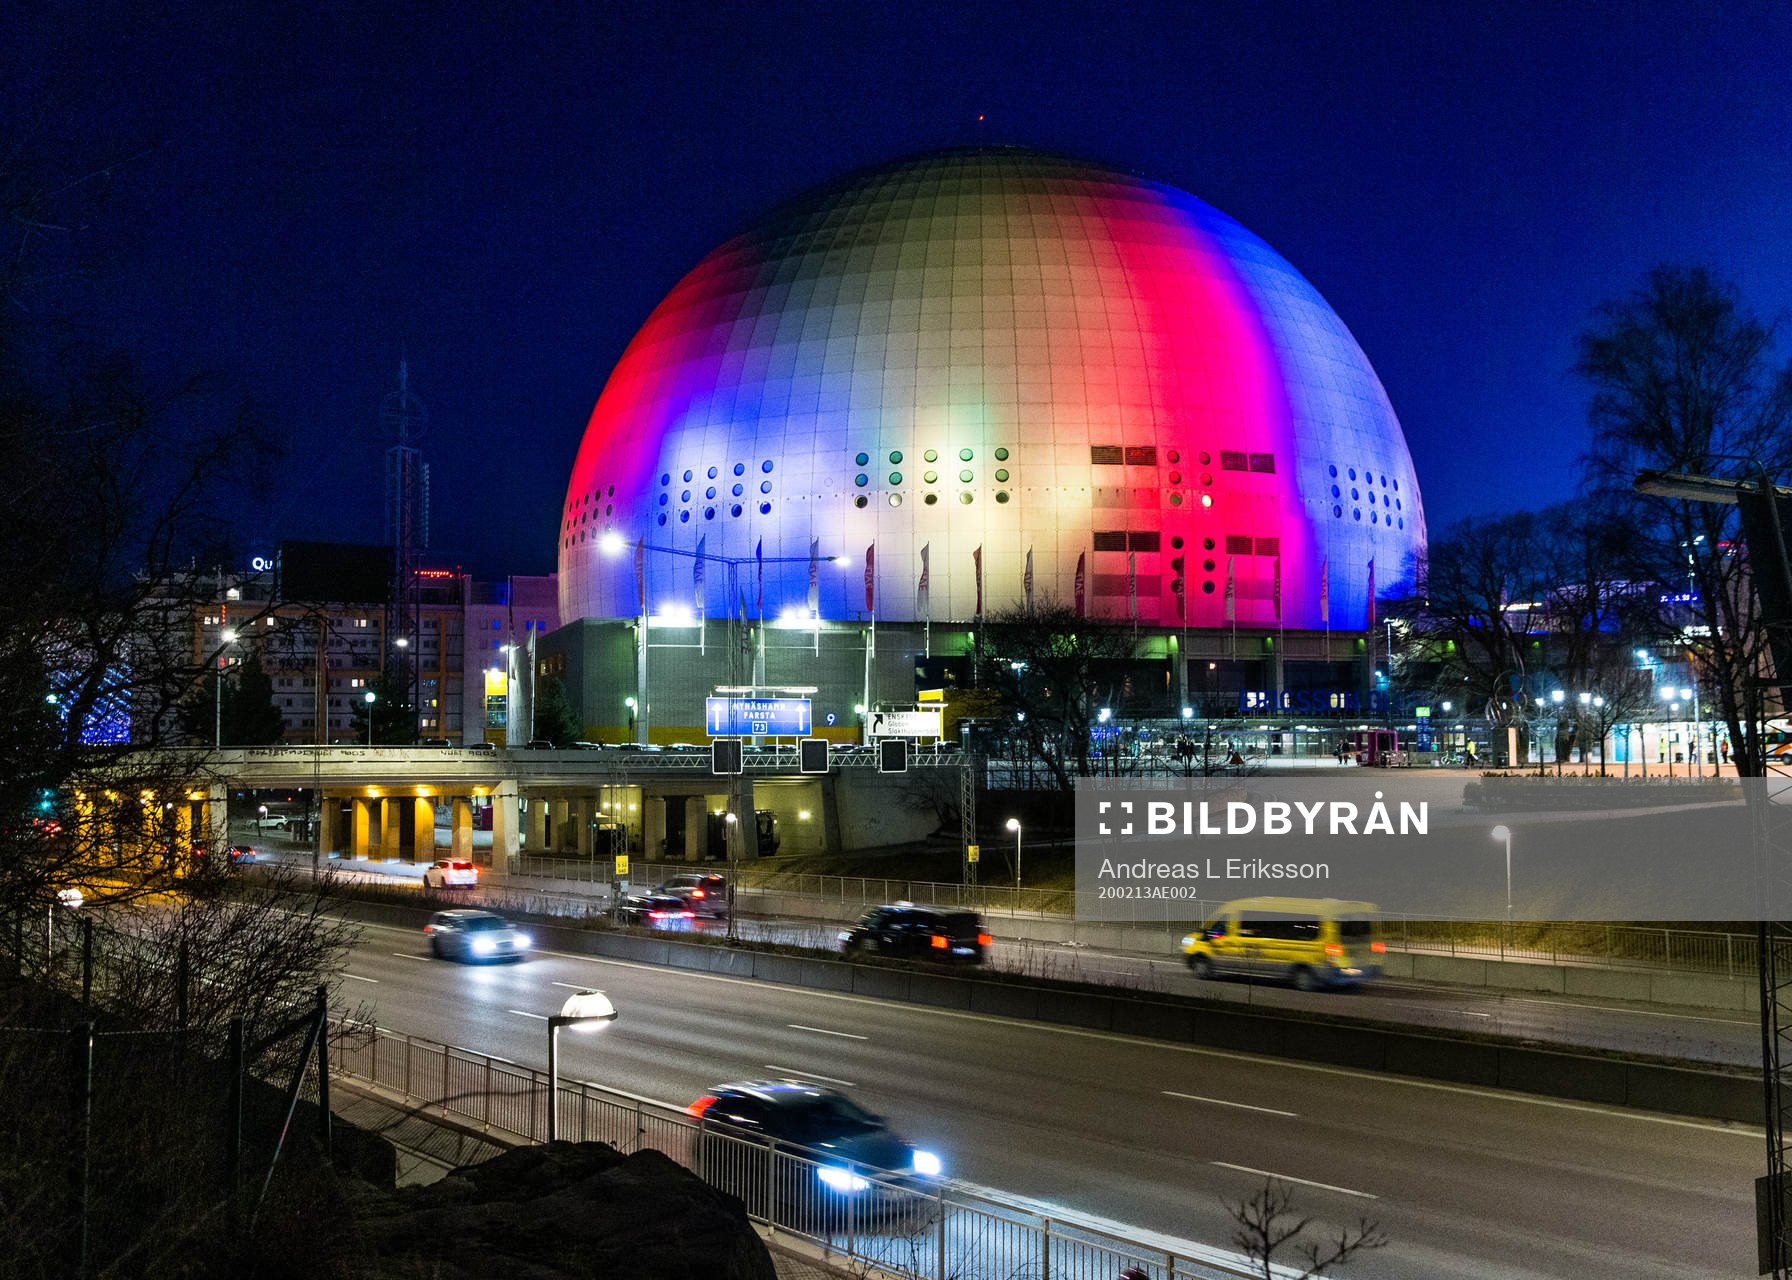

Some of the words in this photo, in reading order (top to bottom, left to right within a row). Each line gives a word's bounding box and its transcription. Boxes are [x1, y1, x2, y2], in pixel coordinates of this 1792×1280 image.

[1239, 689, 1361, 712] ERICSSON
[743, 711, 776, 720] FARSTA
[826, 713, 836, 726] 9
[754, 723, 766, 732] 73
